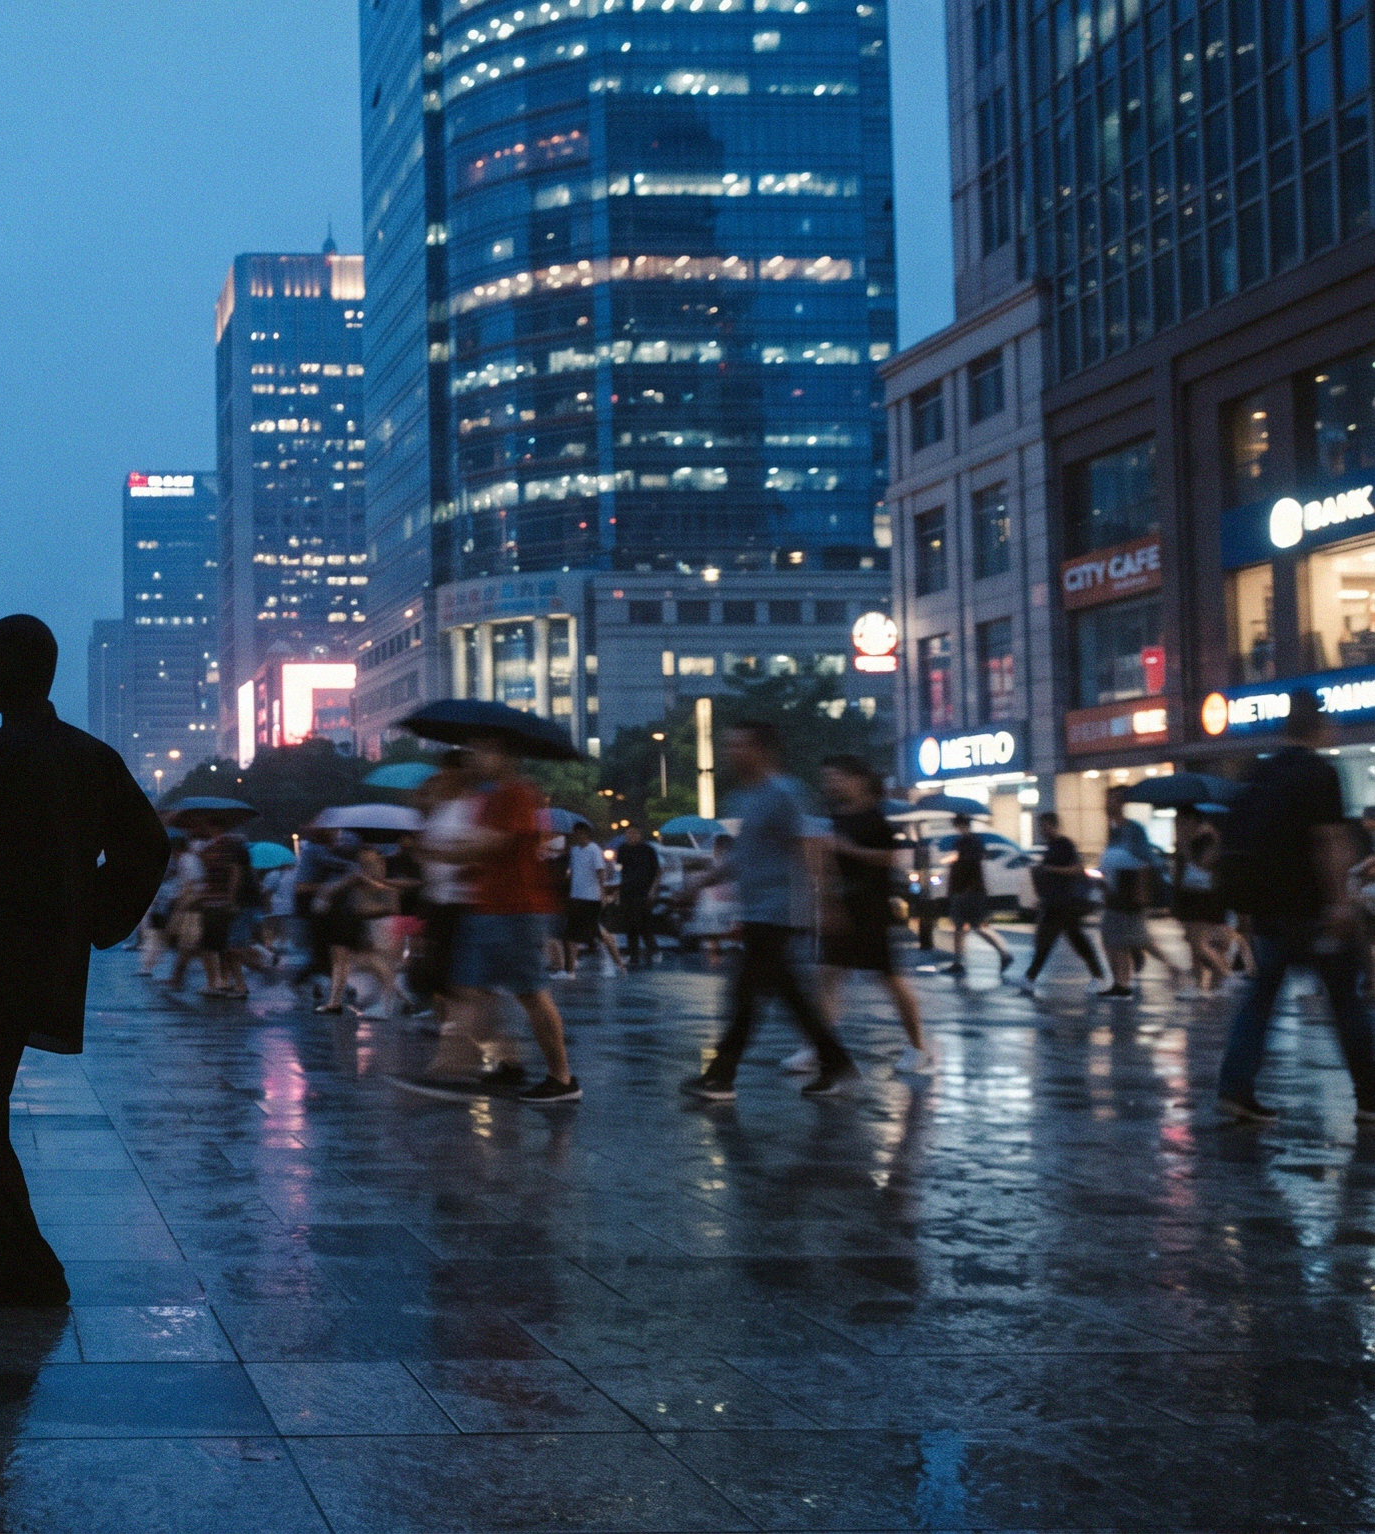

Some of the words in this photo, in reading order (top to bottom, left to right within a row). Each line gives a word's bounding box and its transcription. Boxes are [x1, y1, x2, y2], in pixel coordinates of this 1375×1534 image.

[1304, 485, 1375, 531] BANK
[1064, 561, 1105, 591] CITY
[1228, 693, 1291, 724] METRO
[940, 731, 1015, 770] METRO
